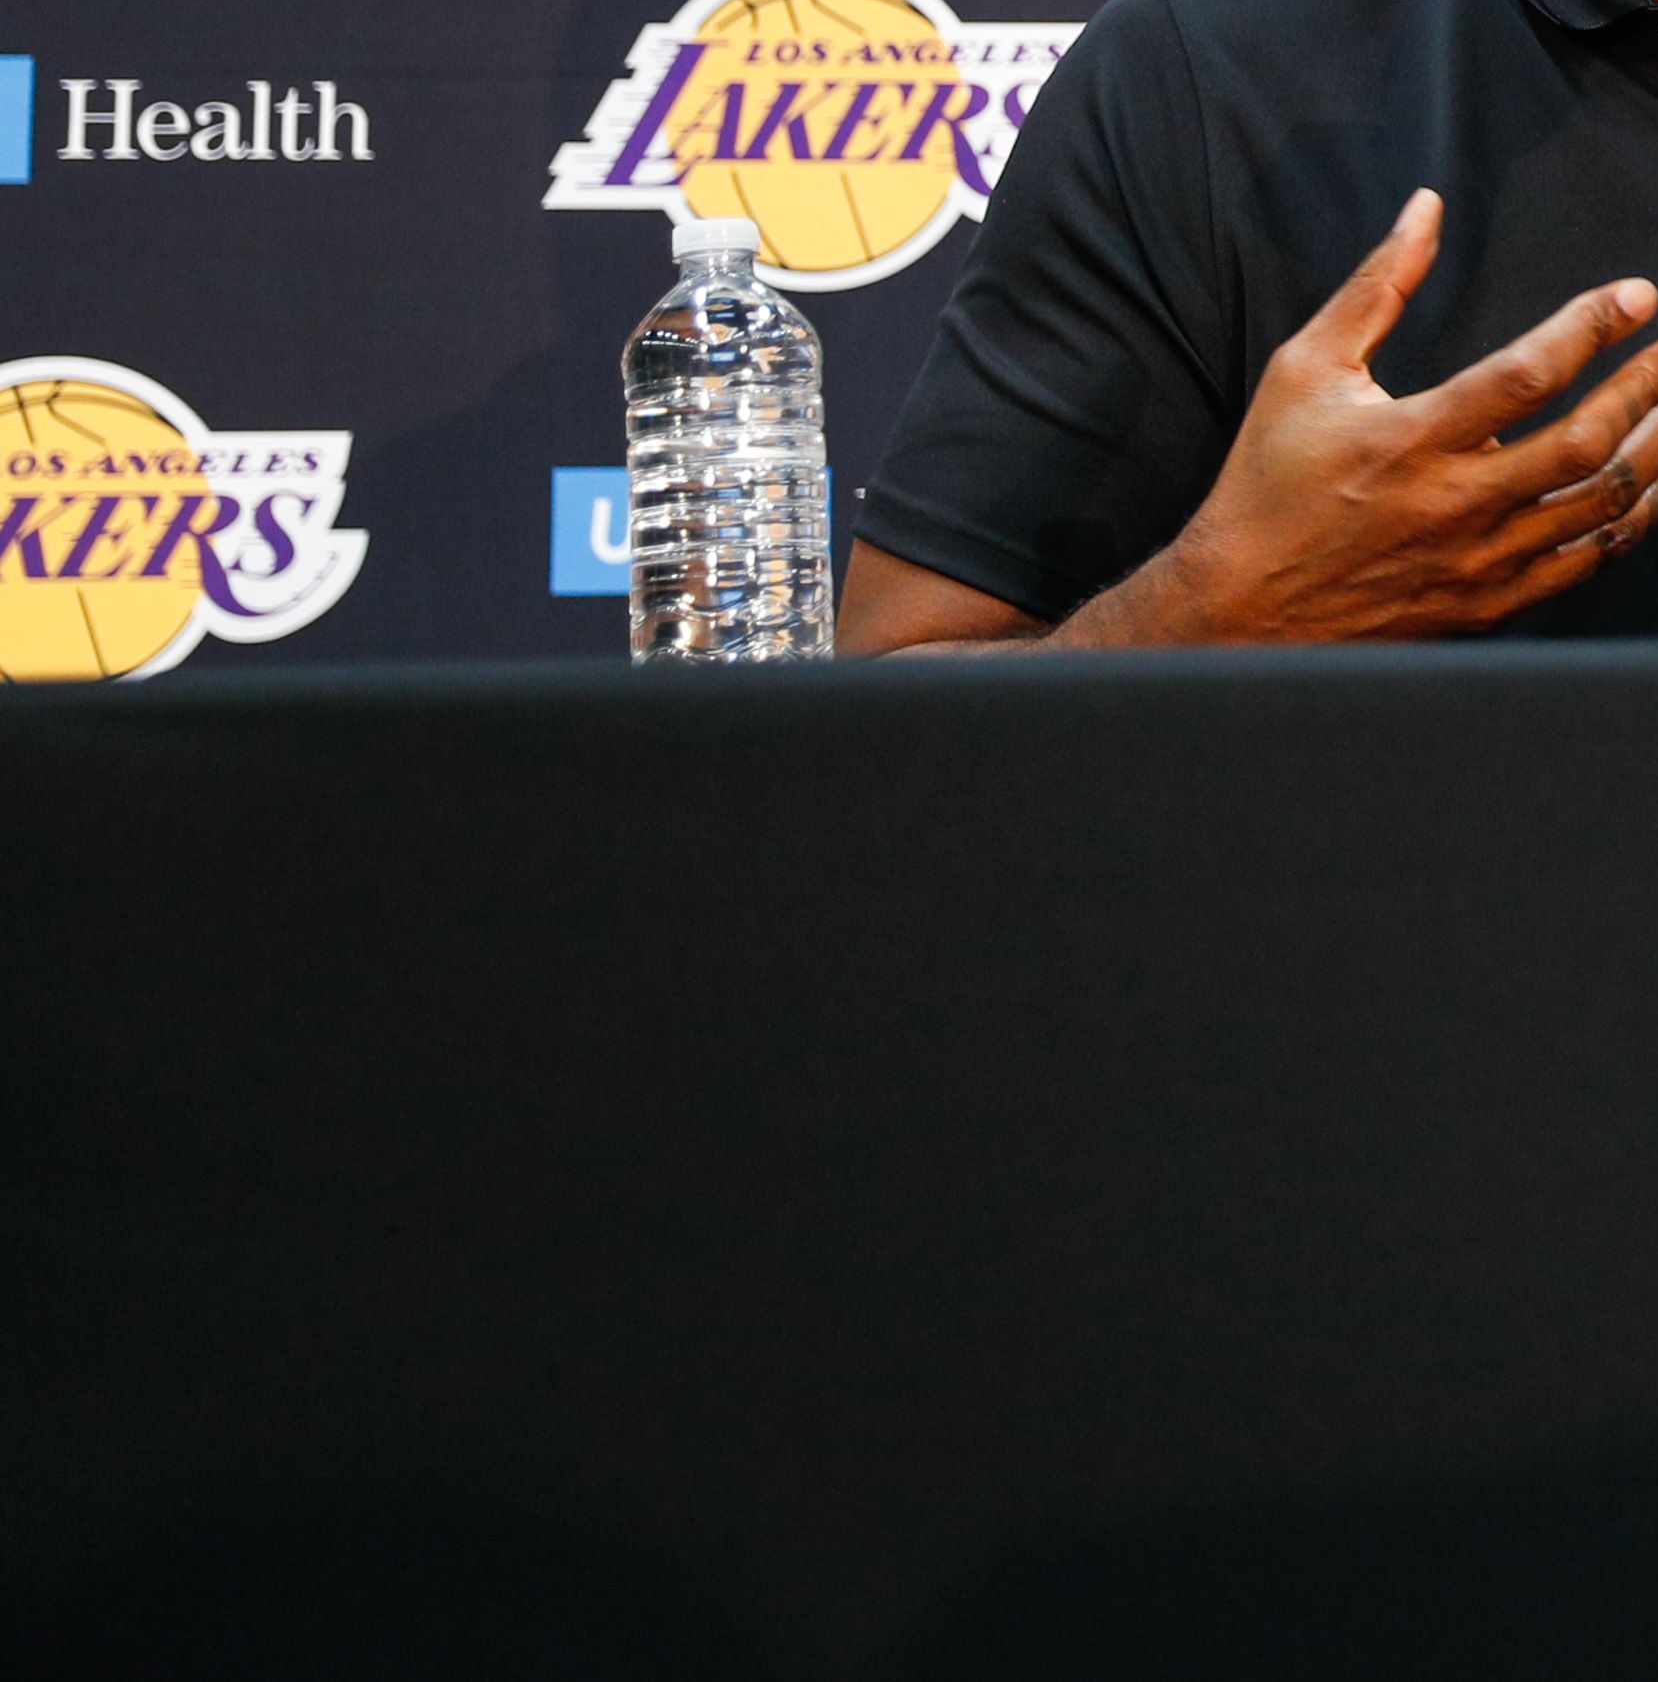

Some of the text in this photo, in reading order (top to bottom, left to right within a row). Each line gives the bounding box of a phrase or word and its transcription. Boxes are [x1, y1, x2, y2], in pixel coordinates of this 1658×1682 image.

[744, 40, 1063, 63] LOS ANGELES
[57, 78, 375, 162] Health
[8, 451, 320, 477] OS ANGELES
[0, 494, 318, 616] KERS
